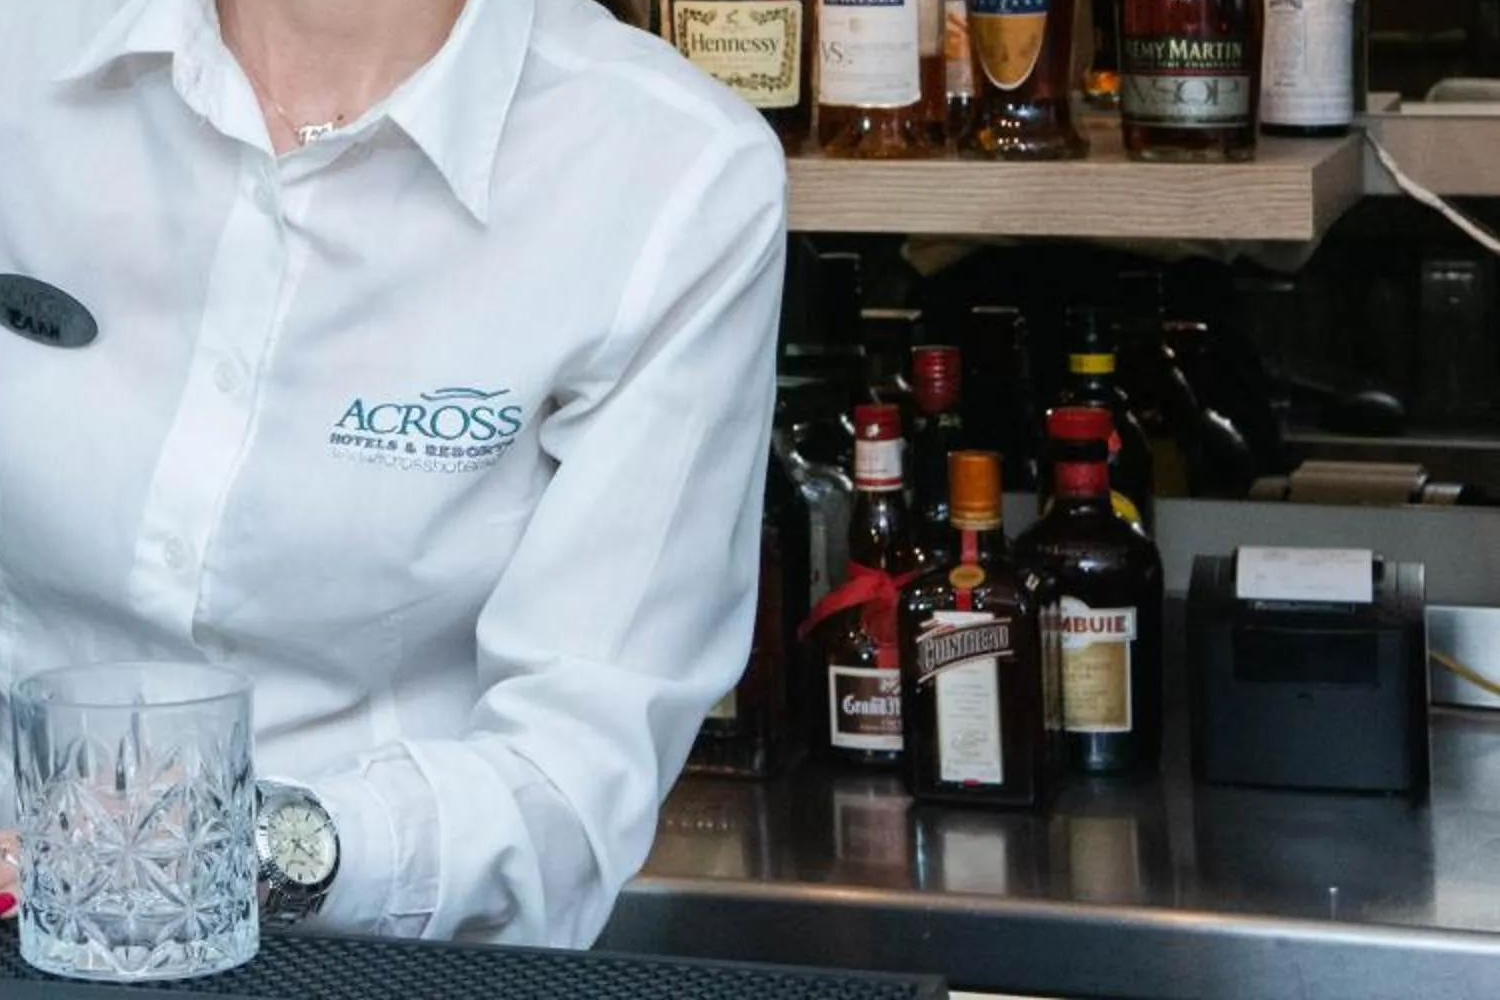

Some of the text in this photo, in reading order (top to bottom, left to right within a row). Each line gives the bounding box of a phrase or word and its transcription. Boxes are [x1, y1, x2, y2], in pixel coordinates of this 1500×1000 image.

[691, 33, 779, 56] Hennessy
[1169, 39, 1242, 60] MARTIN
[334, 397, 524, 442] ACROSS
[329, 432, 399, 451] HOTELS
[920, 626, 1009, 672] COINTREAU
